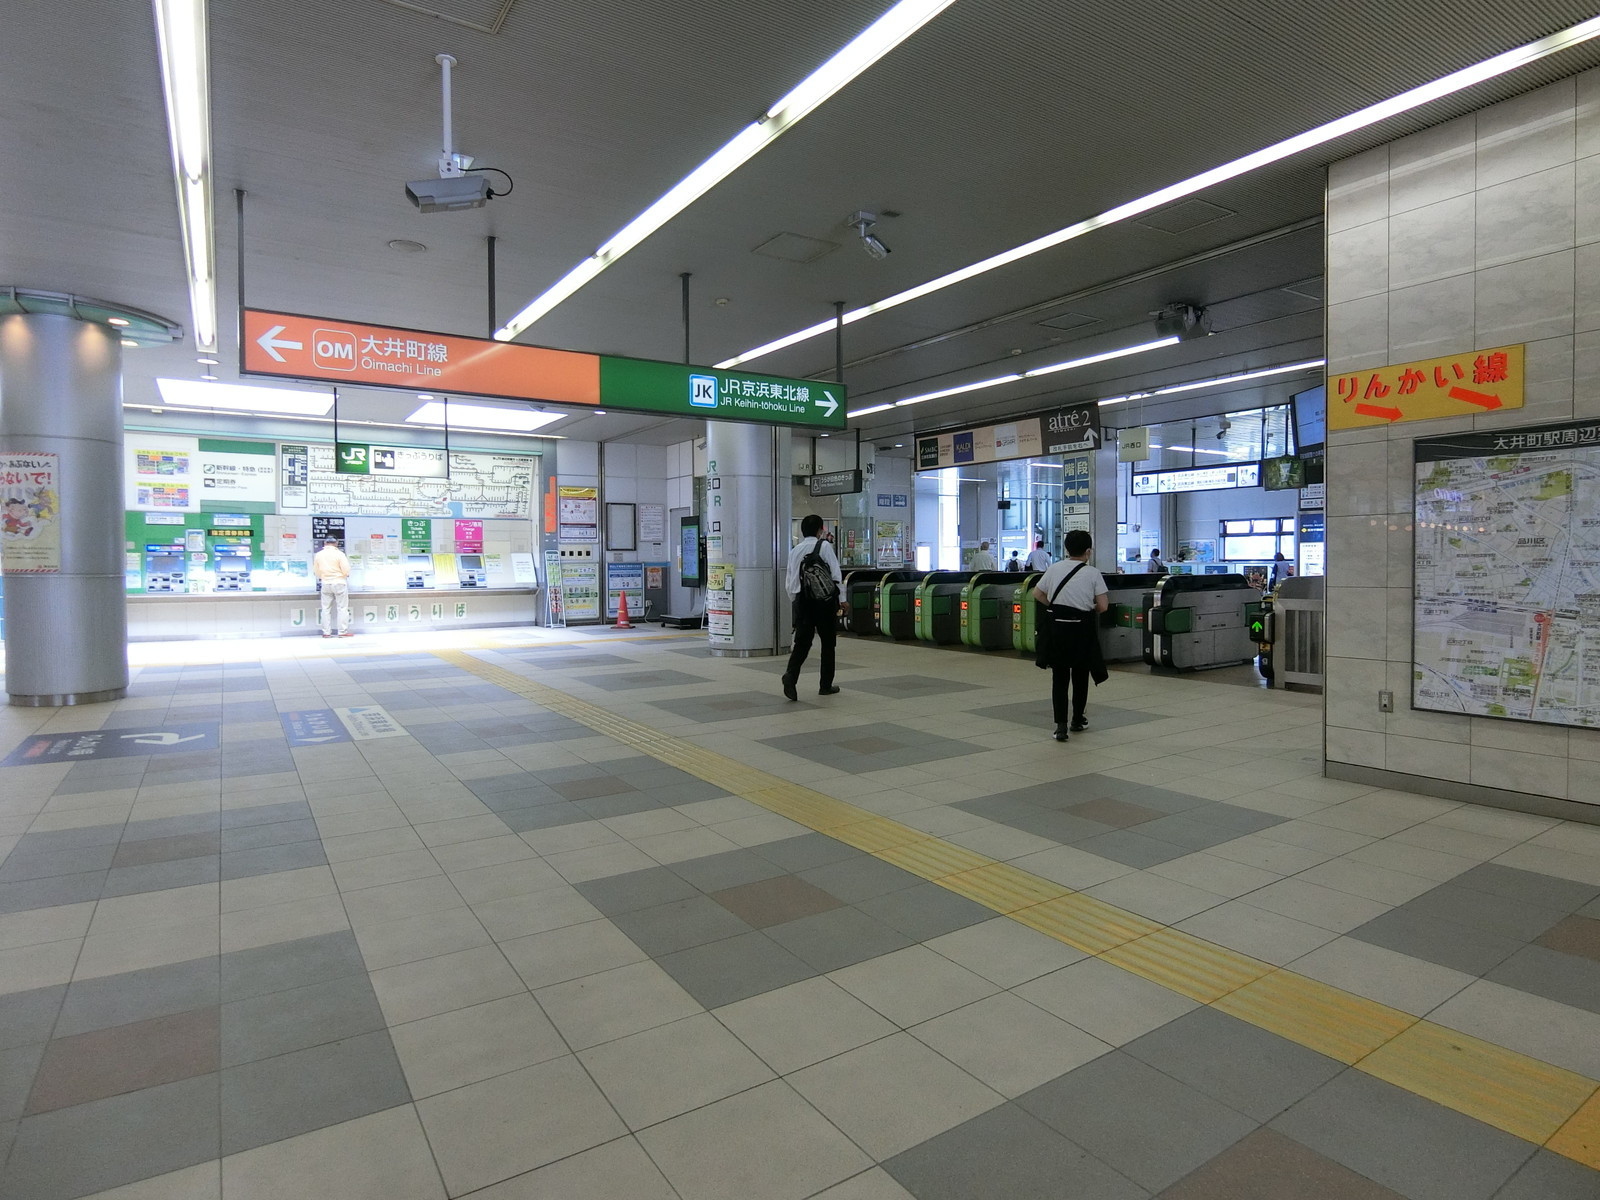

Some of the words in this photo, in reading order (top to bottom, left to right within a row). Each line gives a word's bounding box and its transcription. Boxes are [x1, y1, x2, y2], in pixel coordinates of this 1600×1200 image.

[317, 341, 353, 360] OM
[361, 335, 448, 363] 大井町線
[416, 363, 442, 377] Line
[1338, 352, 1509, 404] りんかい線
[694, 384, 713, 400] JK
[720, 379, 810, 403] JR京浜東北線
[720, 397, 732, 407] JR
[789, 404, 806, 414] Line
[1049, 410, 1080, 430] atré
[1081, 410, 1091, 426] 2
[1493, 425, 1600, 451] 大井町駅周辺
[342, 447, 366, 461] JR
[397, 451, 443, 461] きっぷうりば
[1064, 461, 1089, 477] 階段
